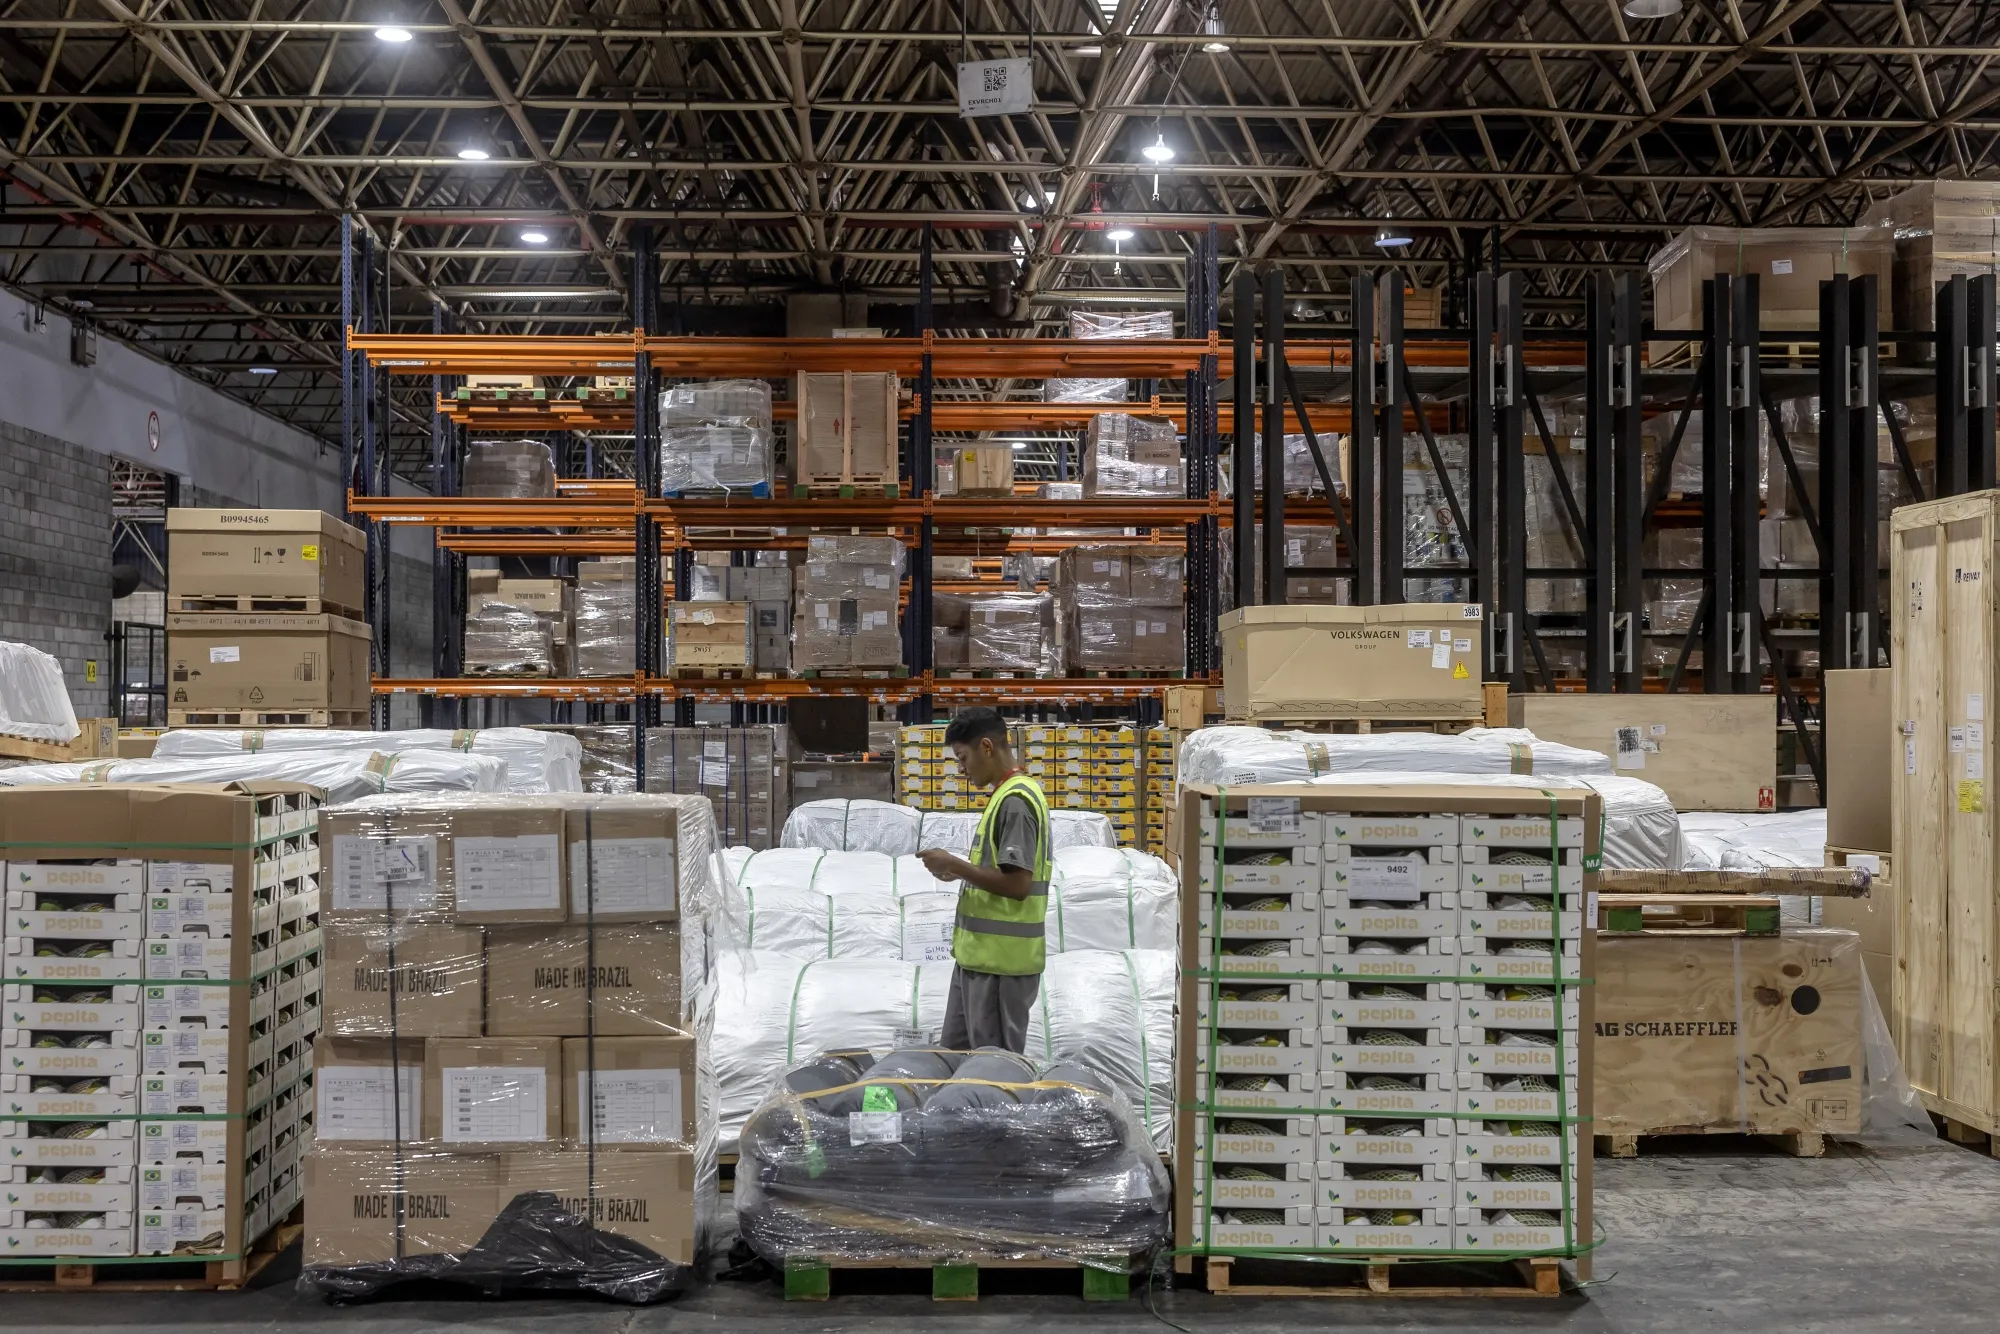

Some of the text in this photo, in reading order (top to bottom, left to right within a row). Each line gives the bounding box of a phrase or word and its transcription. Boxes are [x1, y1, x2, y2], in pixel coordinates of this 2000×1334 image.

[220, 515, 269, 524] B09945465
[1464, 608, 1480, 618] 3983
[1330, 630, 1400, 639] VOLKSWAGEN
[1362, 825, 1418, 840] pepita
[1500, 824, 1552, 839] pepita
[47, 869, 105, 887] pepita
[45, 915, 103, 933] pepita
[1224, 918, 1280, 932] pepita
[1361, 917, 1418, 932] pepita
[1497, 918, 1552, 933] pepita
[42, 963, 101, 979] pepita
[1223, 961, 1280, 974] pepita
[1358, 960, 1416, 975] pepita
[1497, 961, 1552, 976] pepita
[354, 968, 387, 991] MADE
[535, 966, 632, 988] MADE IN BRAZIL
[41, 1009, 99, 1026] pepita
[1222, 1008, 1279, 1023] pepita
[1358, 1007, 1416, 1022] pepita
[1495, 1006, 1551, 1020] pepita
[40, 1053, 98, 1071] pepita
[1220, 1052, 1277, 1068] pepita
[1358, 1050, 1415, 1065] pepita
[1494, 1050, 1551, 1065] pepita
[38, 1098, 96, 1114] pepita
[1220, 1096, 1277, 1108] pepita
[1357, 1096, 1414, 1110] pepita
[1494, 1096, 1552, 1111] pepita
[38, 1142, 96, 1160] pepita
[1218, 1139, 1275, 1154] pepita
[1356, 1140, 1414, 1155] pepita
[1493, 1142, 1550, 1157] pepita
[34, 1189, 92, 1207] pepita
[1218, 1185, 1275, 1199] pepita
[1355, 1187, 1412, 1202] pepita
[1493, 1188, 1550, 1203] pepita
[354, 1195, 387, 1218] MADE
[409, 1195, 449, 1218] BRAZIL
[609, 1198, 649, 1222] BRAZIL
[35, 1232, 93, 1250] pepita
[1217, 1231, 1274, 1245] pepita
[1356, 1233, 1412, 1248] pepita
[1493, 1231, 1550, 1246] pepita
